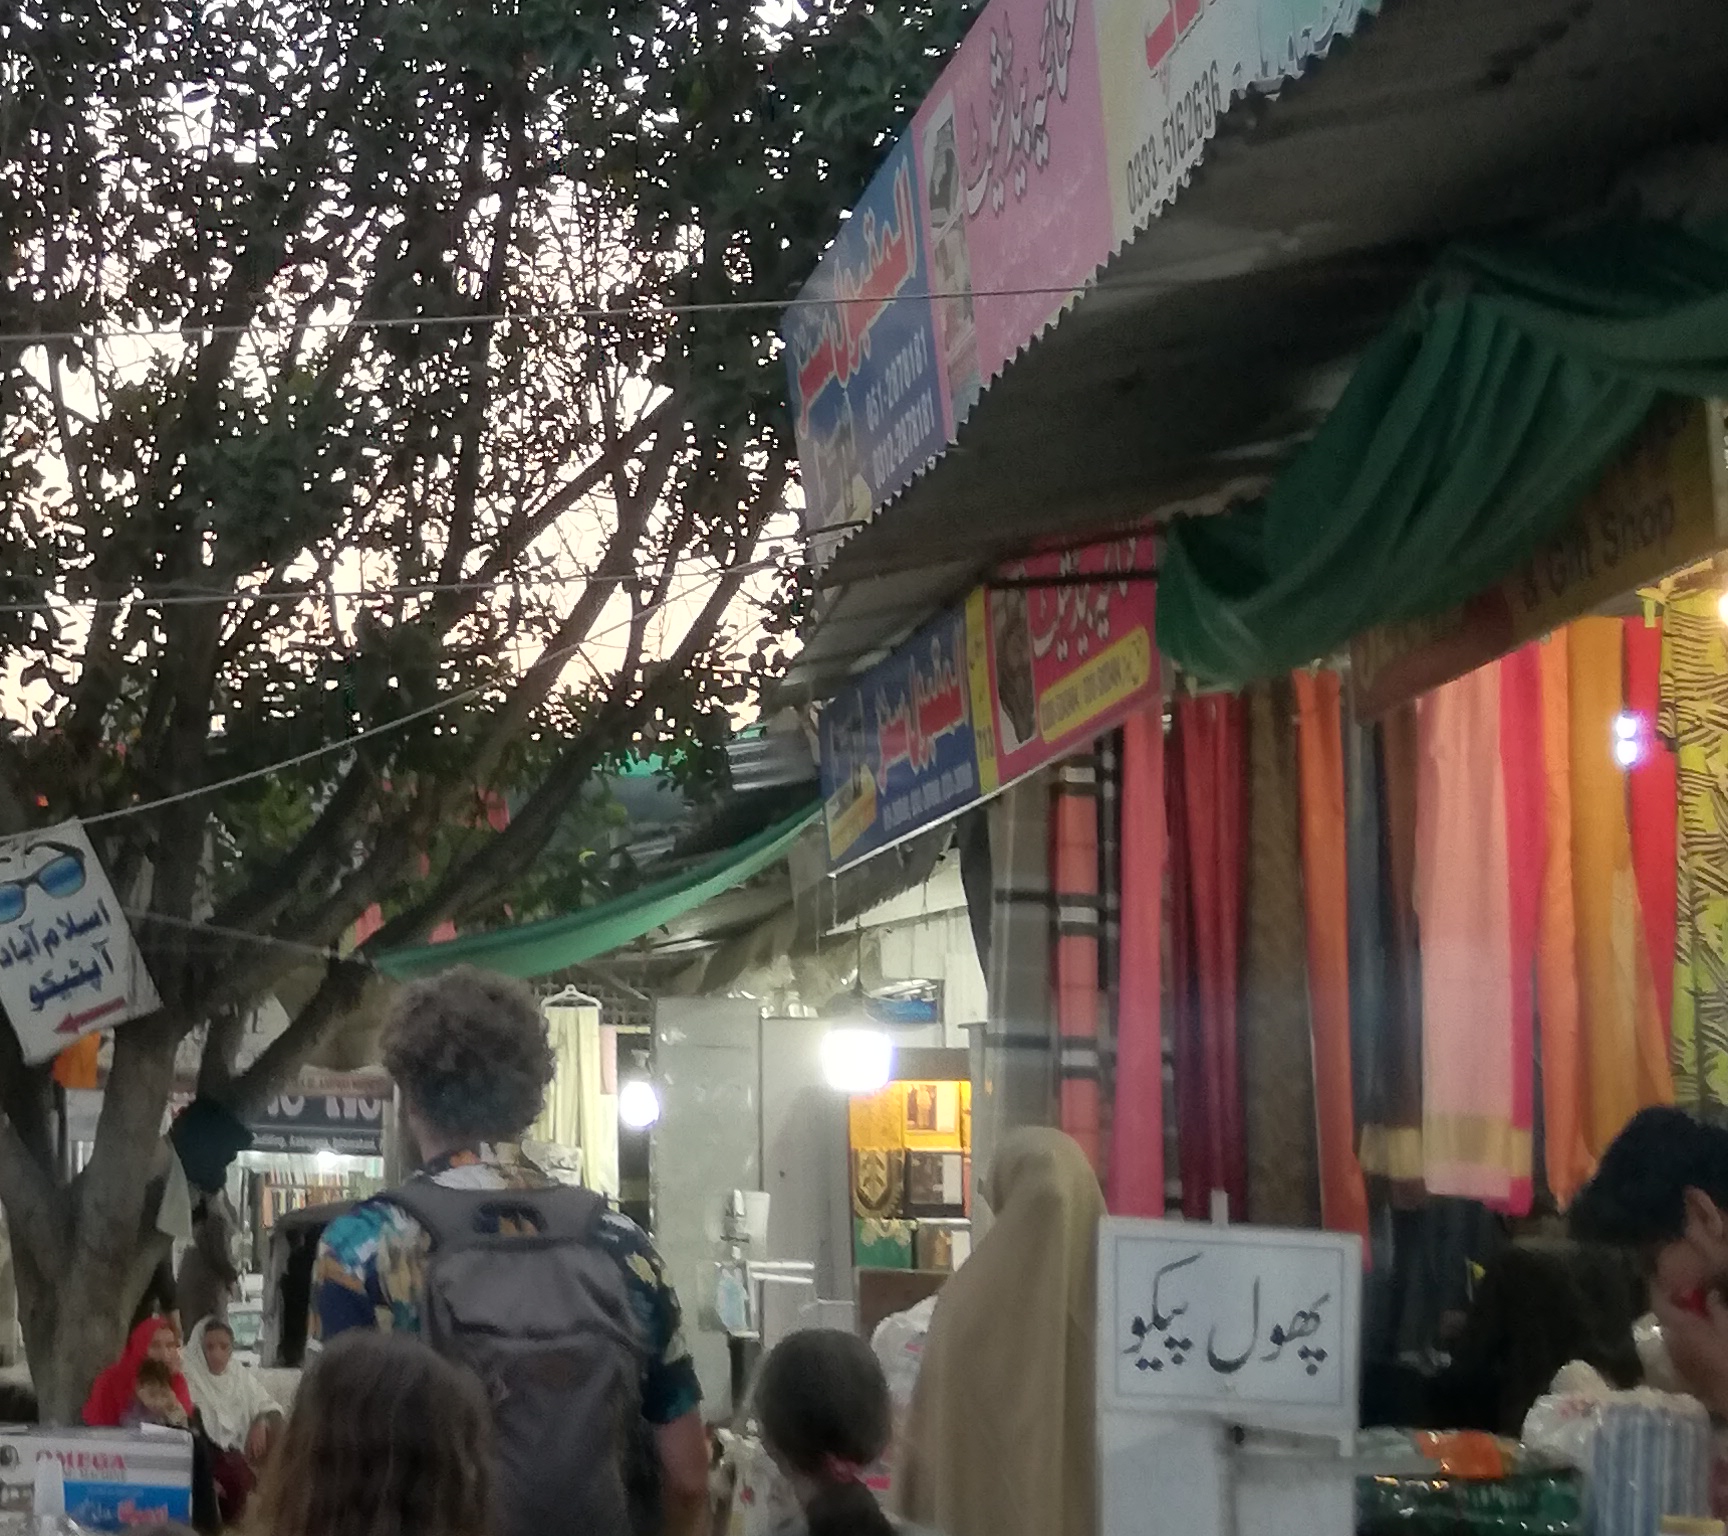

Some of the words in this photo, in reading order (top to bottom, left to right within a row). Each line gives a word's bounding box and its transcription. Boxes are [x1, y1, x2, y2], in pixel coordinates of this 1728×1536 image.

[1125, 58, 1221, 216] 0333-5162636
[0, 918, 41, 969] آباد
[41, 897, 113, 960] اسلام
[1123, 1252, 1204, 1372] پیکو
[1207, 1275, 1331, 1376] پھول
